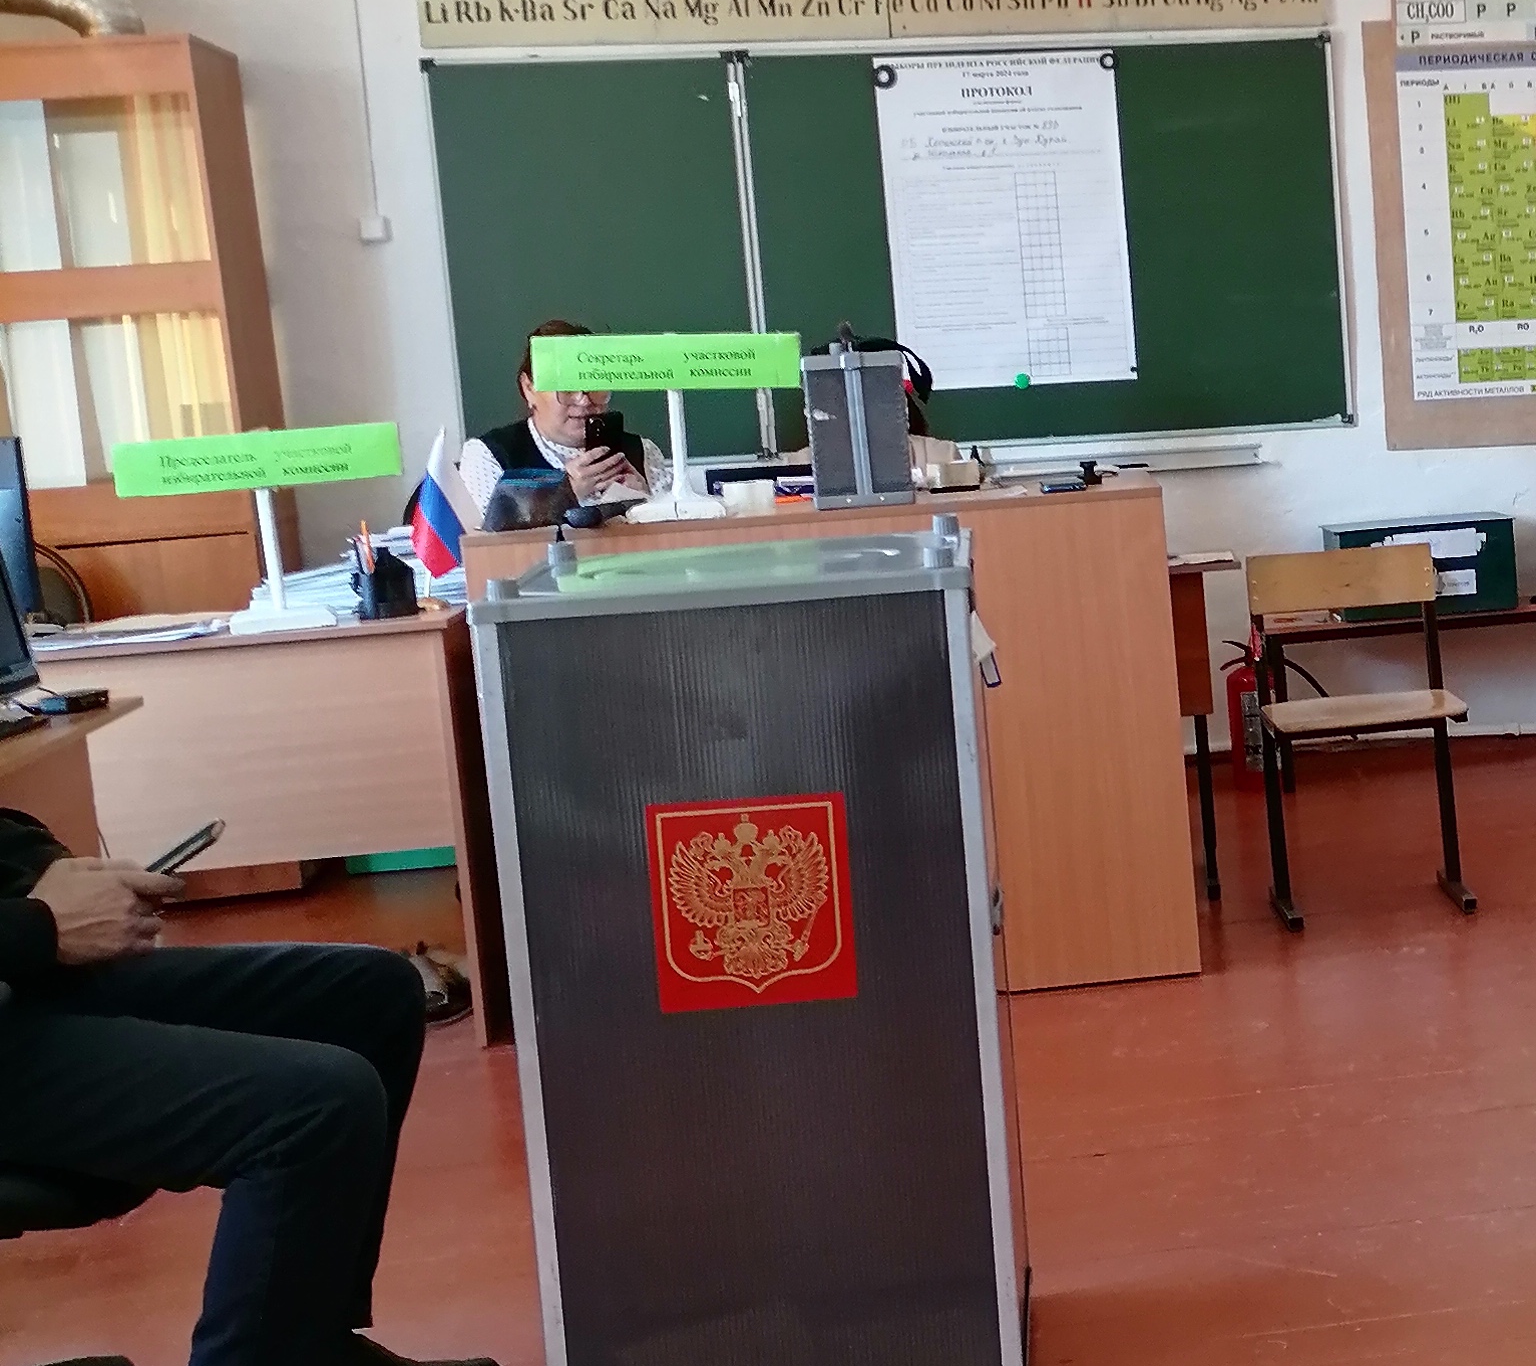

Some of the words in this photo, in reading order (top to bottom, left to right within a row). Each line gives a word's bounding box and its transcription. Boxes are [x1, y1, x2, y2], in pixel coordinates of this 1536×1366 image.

[424, 0, 449, 24] Li
[455, 0, 492, 24] Rb
[986, 57, 1047, 68] РОССИЙСКОЙ
[1418, 52, 1524, 67] ПЕРИОДИЧЕСКАЯ
[1400, 79, 1440, 88] ПЕРИОДЫ
[960, 85, 1033, 99] ПРОТОКОЛ
[1517, 323, 1529, 331] RO
[577, 351, 644, 365] Секретарь
[683, 348, 756, 364] участковой
[578, 367, 675, 384] избирательной
[689, 365, 752, 378] комиссии
[1417, 389, 1433, 399] РЯД
[1434, 387, 1483, 398] АКТИВНОСТИ
[1484, 385, 1525, 396] МЕТАЛЛОВ
[159, 452, 258, 471] Председатель
[273, 442, 352, 463] участковой
[161, 467, 266, 487] избирательной
[282, 462, 349, 478] комиссии
